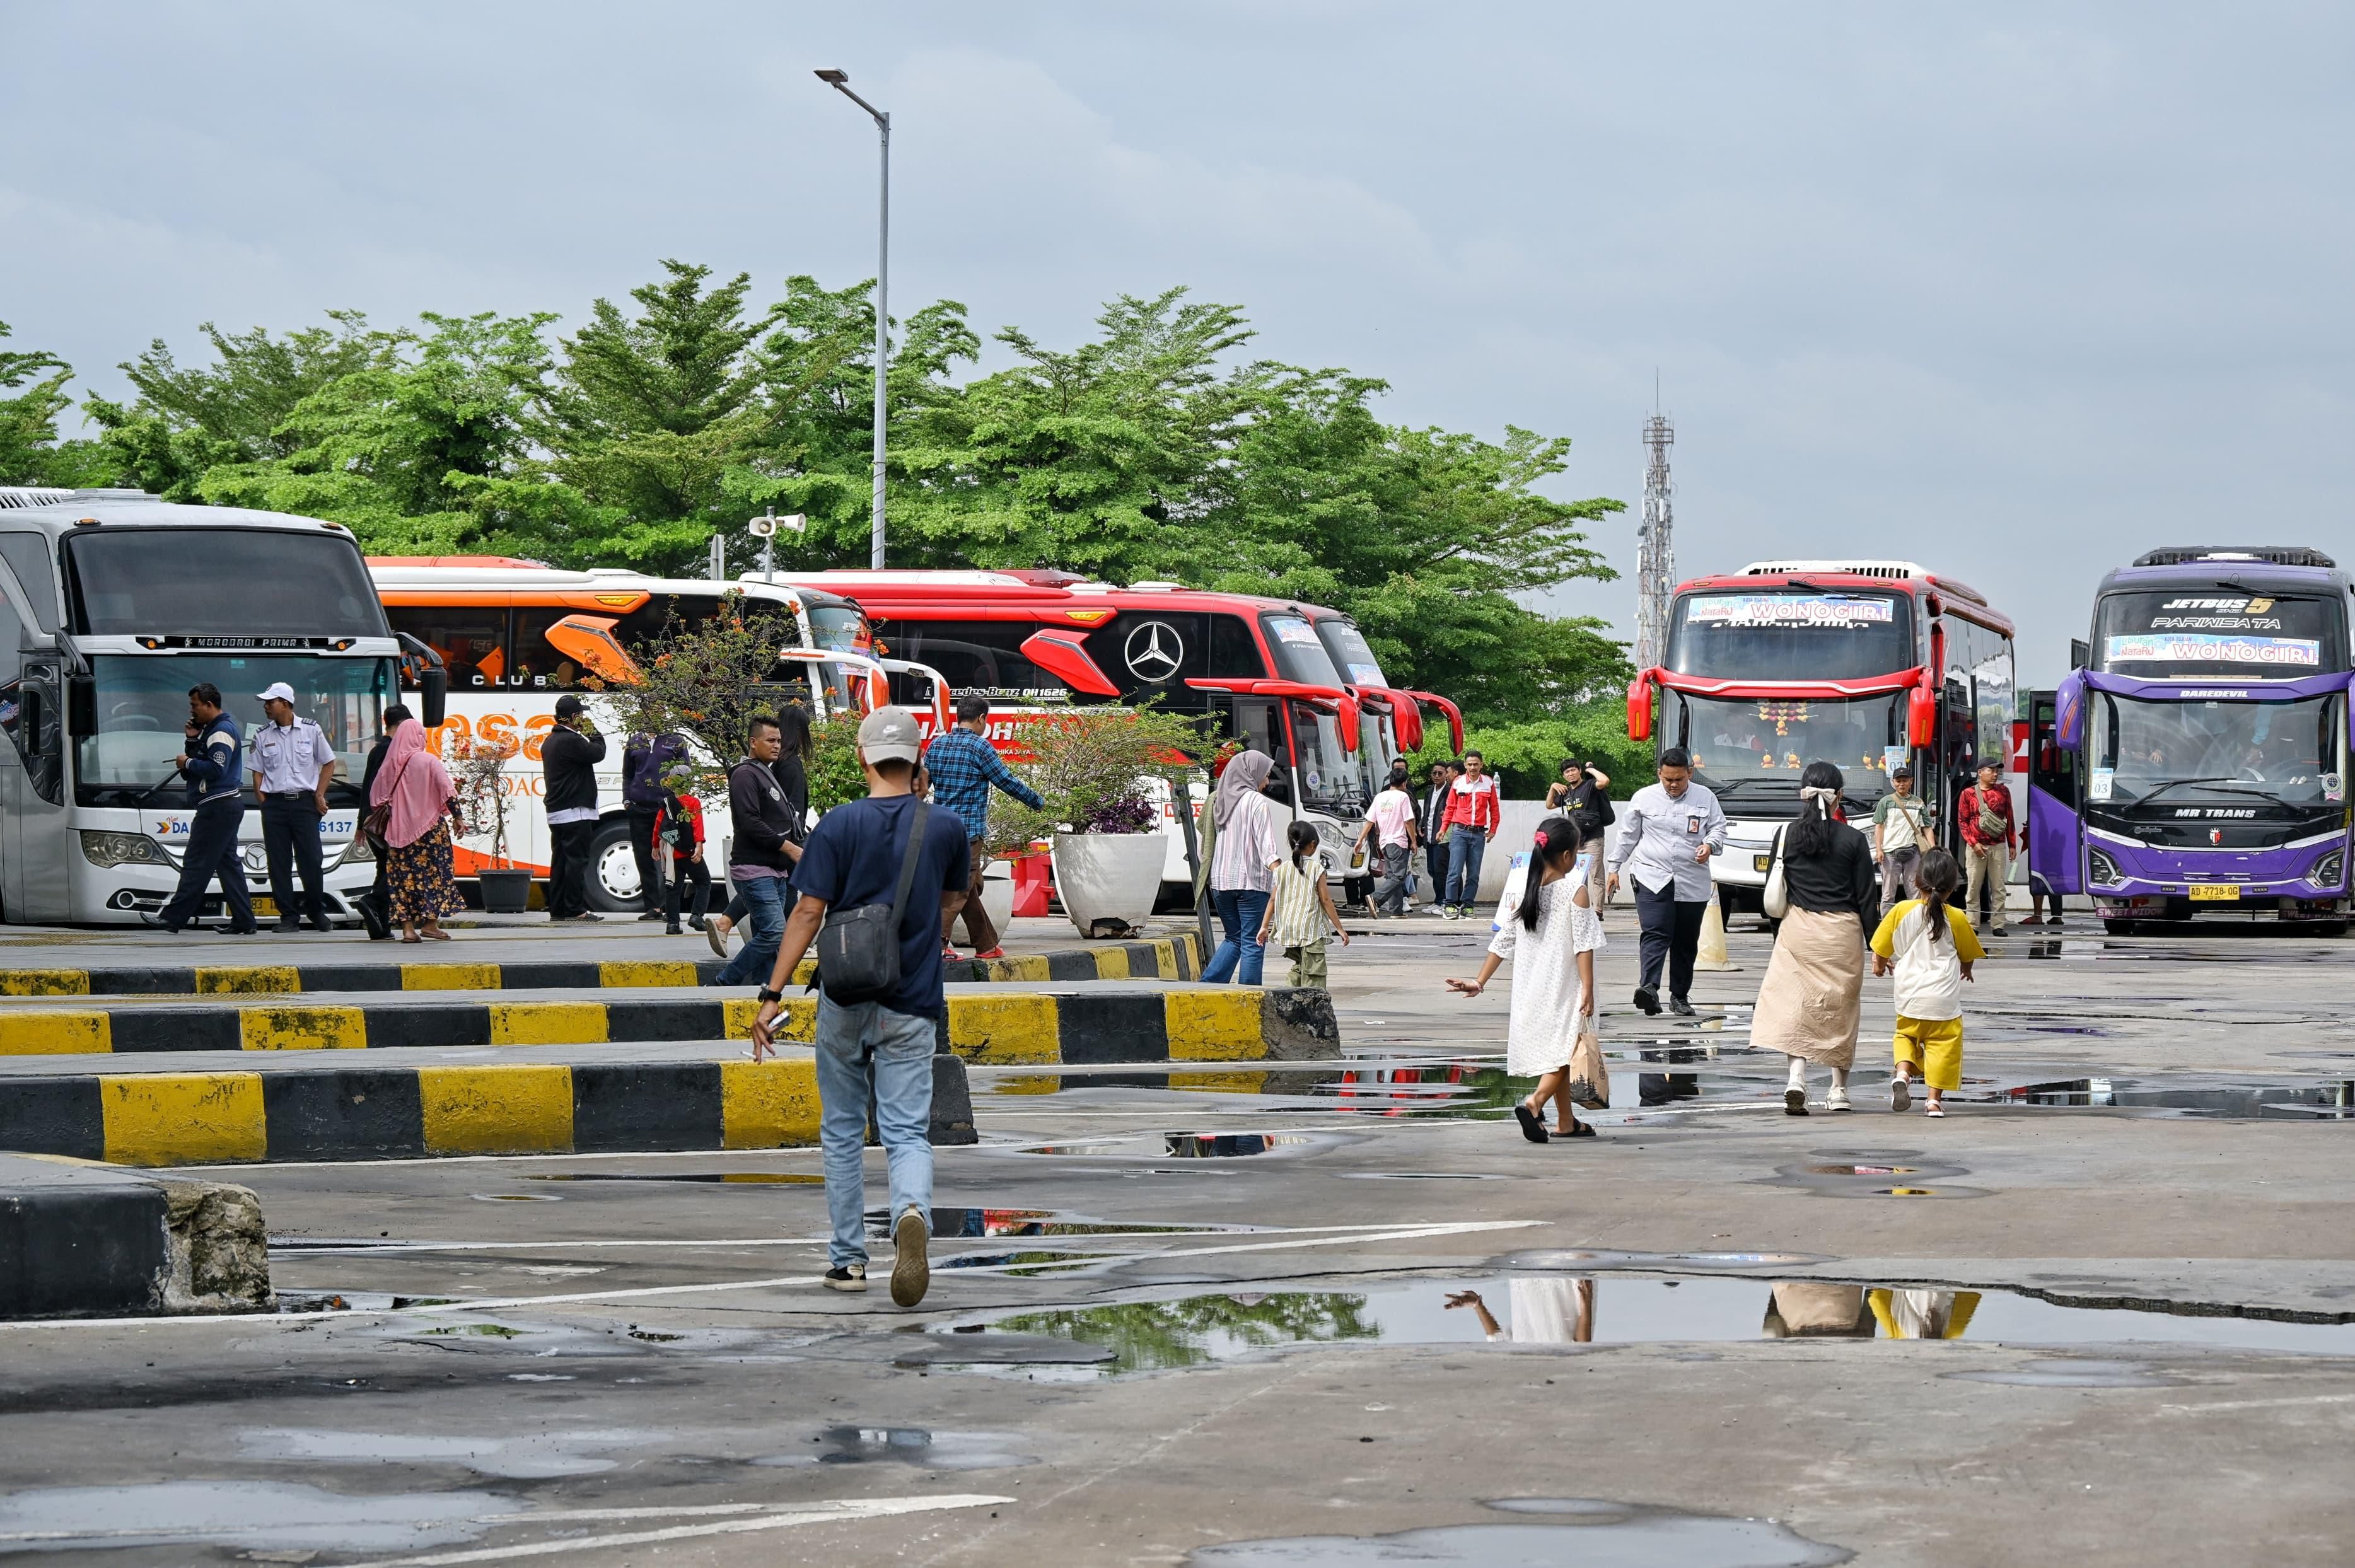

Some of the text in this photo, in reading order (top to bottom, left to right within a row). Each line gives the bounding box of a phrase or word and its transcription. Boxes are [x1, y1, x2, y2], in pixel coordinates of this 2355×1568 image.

[2163, 597, 2276, 613] JETBUS 5
[1751, 604, 1887, 620] WONOGIRI
[2151, 617, 2281, 629] PARIWISATA
[2173, 644, 2315, 663] WONOGIRI
[472, 675, 547, 686] CLUB
[925, 686, 1020, 696] cedes-Benz
[2095, 783, 2108, 794] 03
[2175, 808, 2257, 818] MR TRANS
[172, 822, 189, 834] DA
[1758, 857, 1767, 866] AD
[2191, 886, 2238, 896] AD 7718 OG
[2097, 907, 2165, 917] SWEET WIDOW
